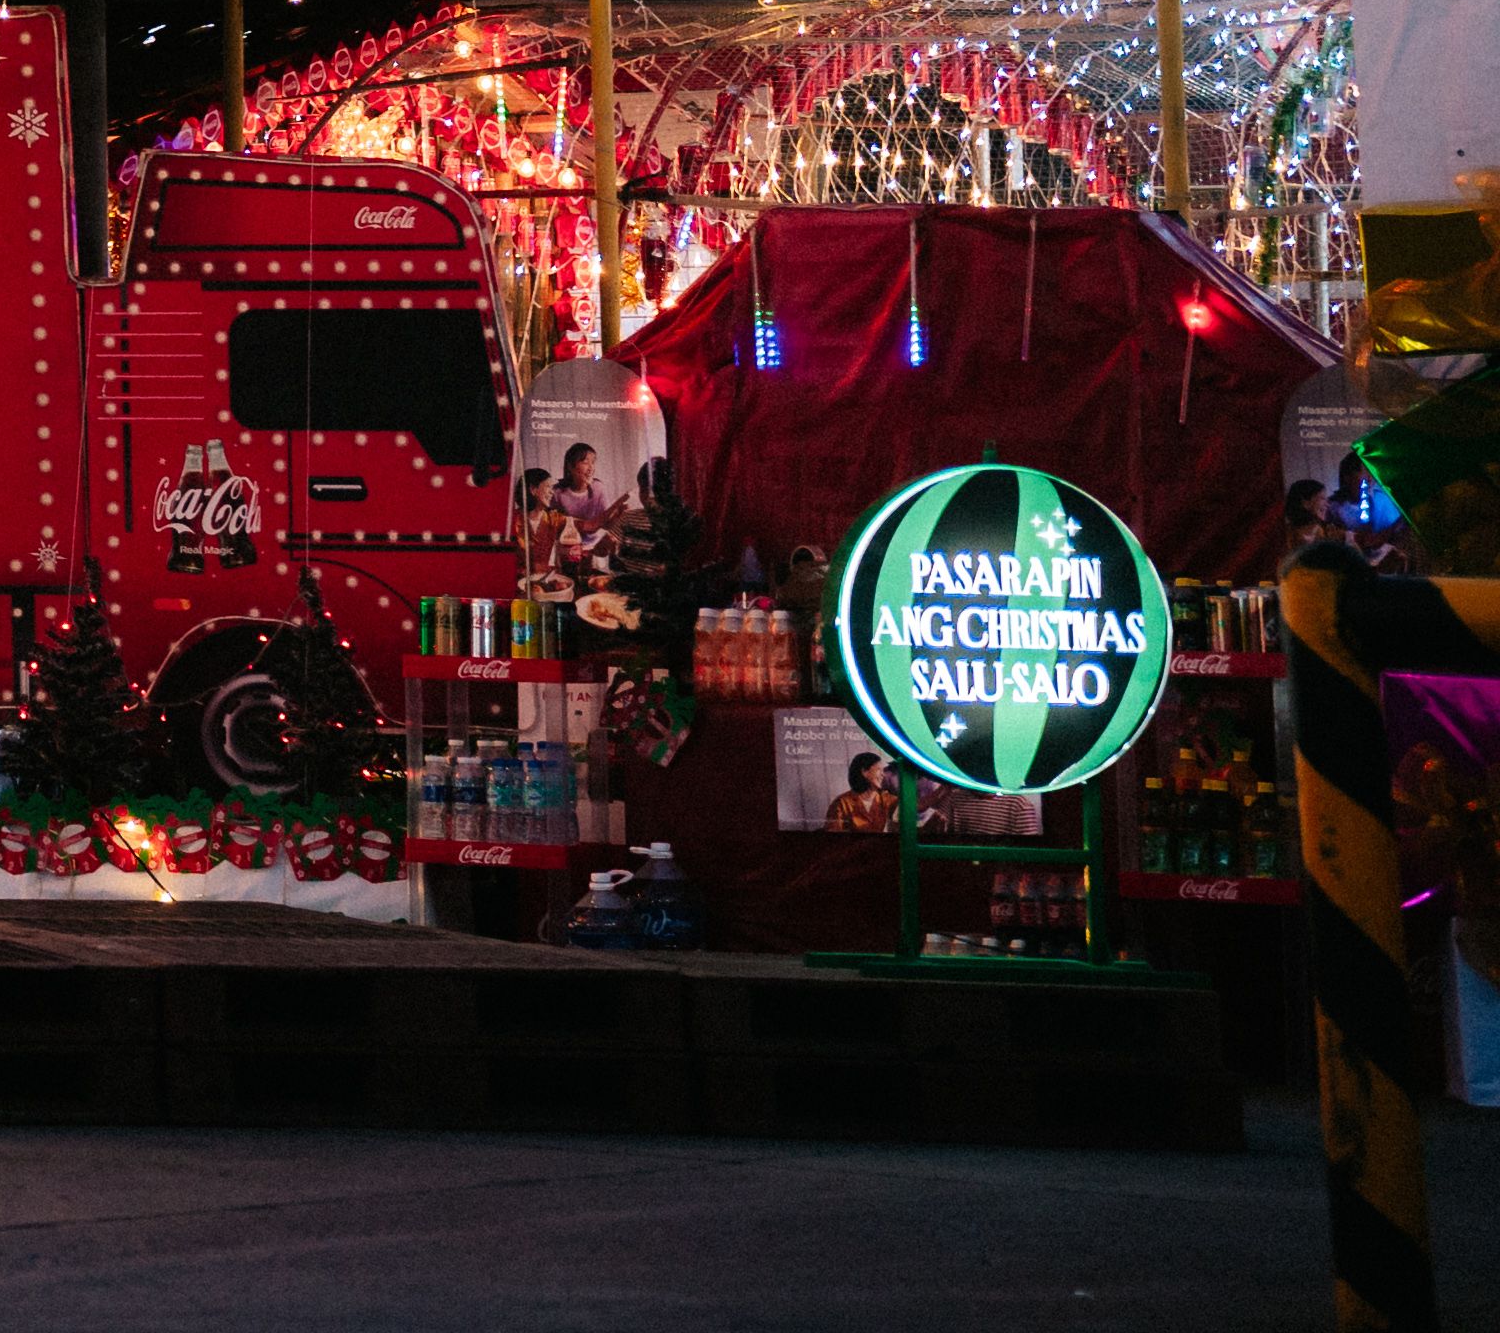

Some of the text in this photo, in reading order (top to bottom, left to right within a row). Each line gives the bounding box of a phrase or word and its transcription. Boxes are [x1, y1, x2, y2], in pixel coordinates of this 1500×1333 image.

[353, 205, 419, 230] Coca-Cola
[152, 476, 262, 536] Coca-Cola
[180, 545, 235, 557] Real Magic
[909, 551, 1102, 600] PASARAPIN
[870, 604, 1148, 654] ANG CHRISTMAS
[457, 660, 512, 679] Coca-Cola
[1170, 653, 1231, 675] Coca-Cola
[910, 656, 1111, 707] SALU-SALO
[458, 844, 514, 865] Coca-Cola
[1178, 878, 1240, 901] Coca-Cola
